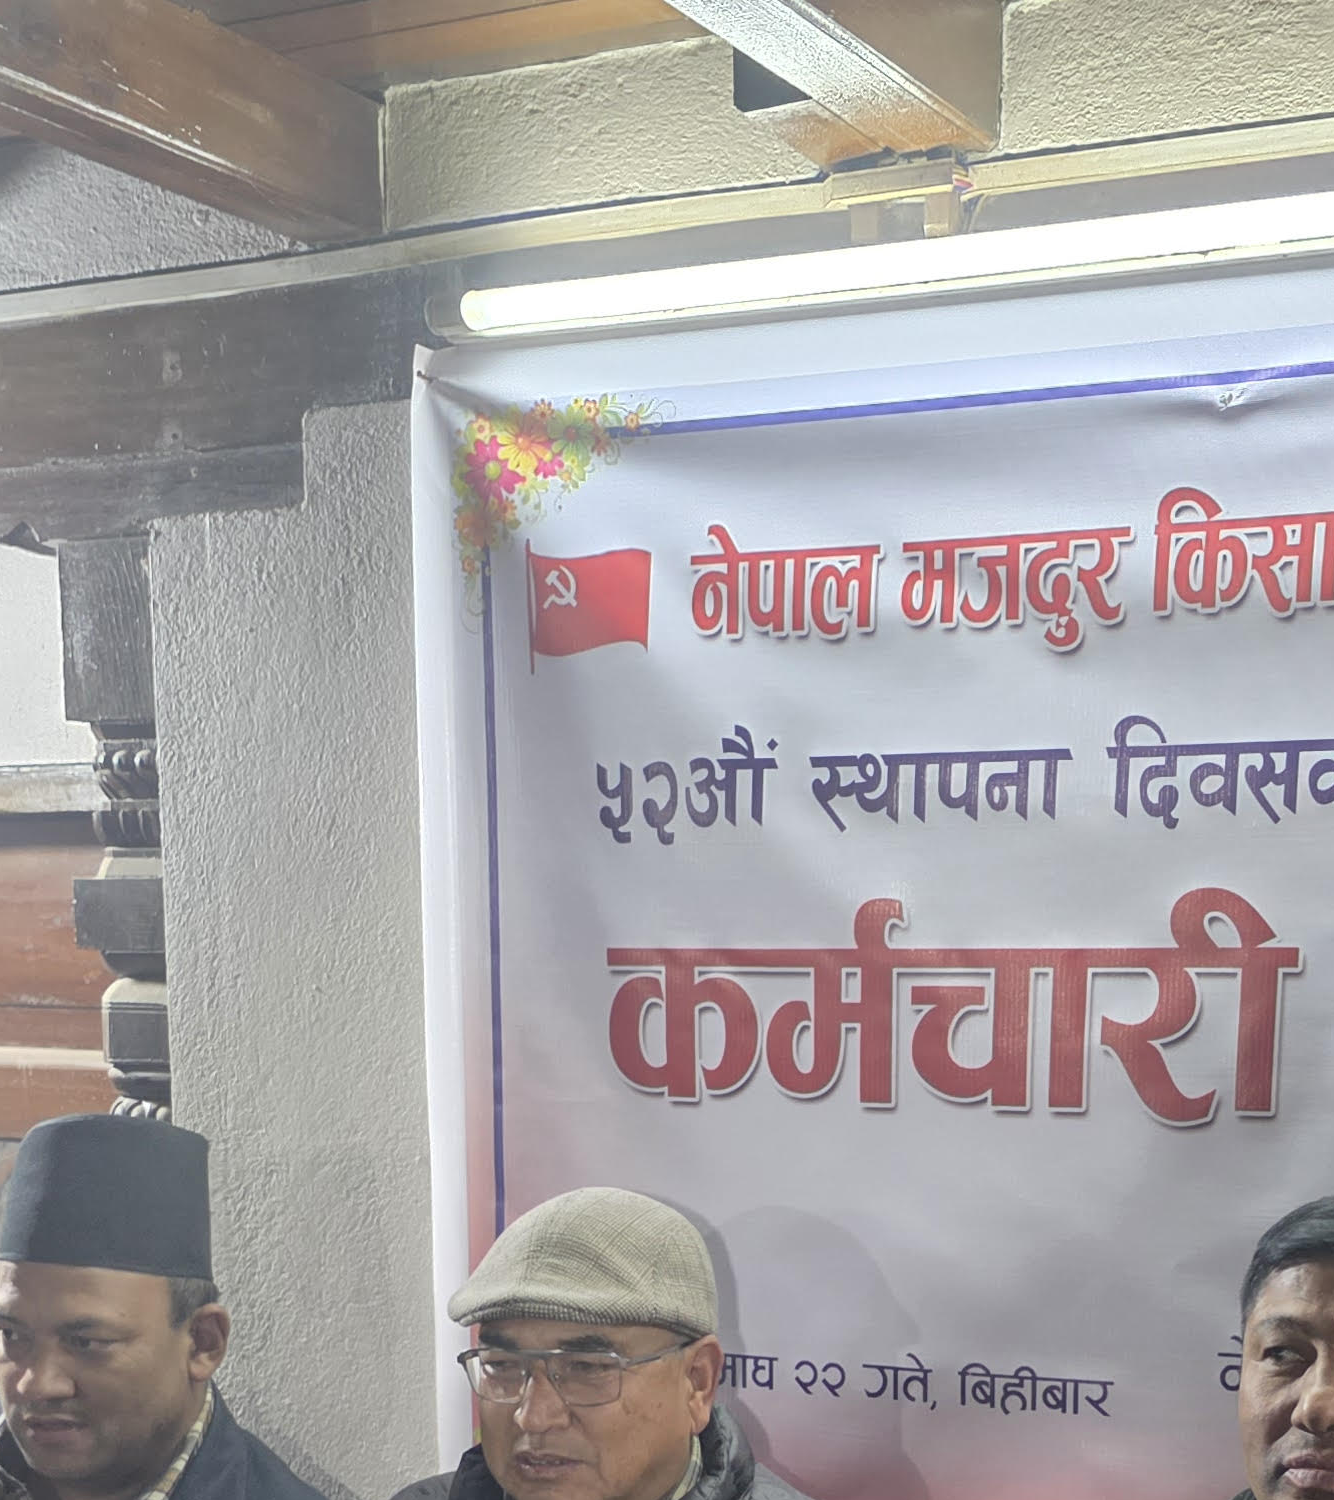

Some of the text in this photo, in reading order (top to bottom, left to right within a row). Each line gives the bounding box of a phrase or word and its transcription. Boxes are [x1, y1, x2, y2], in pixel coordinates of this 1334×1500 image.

[688, 524, 882, 640] नेपाल
[898, 526, 1134, 652] मजदुर
[595, 724, 779, 846] ५२औं
[808, 747, 1075, 833] स्थापना
[605, 884, 1303, 1124] कर्मचारी
[794, 1360, 846, 1398] २२
[862, 1352, 937, 1411] गते,
[957, 1362, 1115, 1417] बिहीबार
